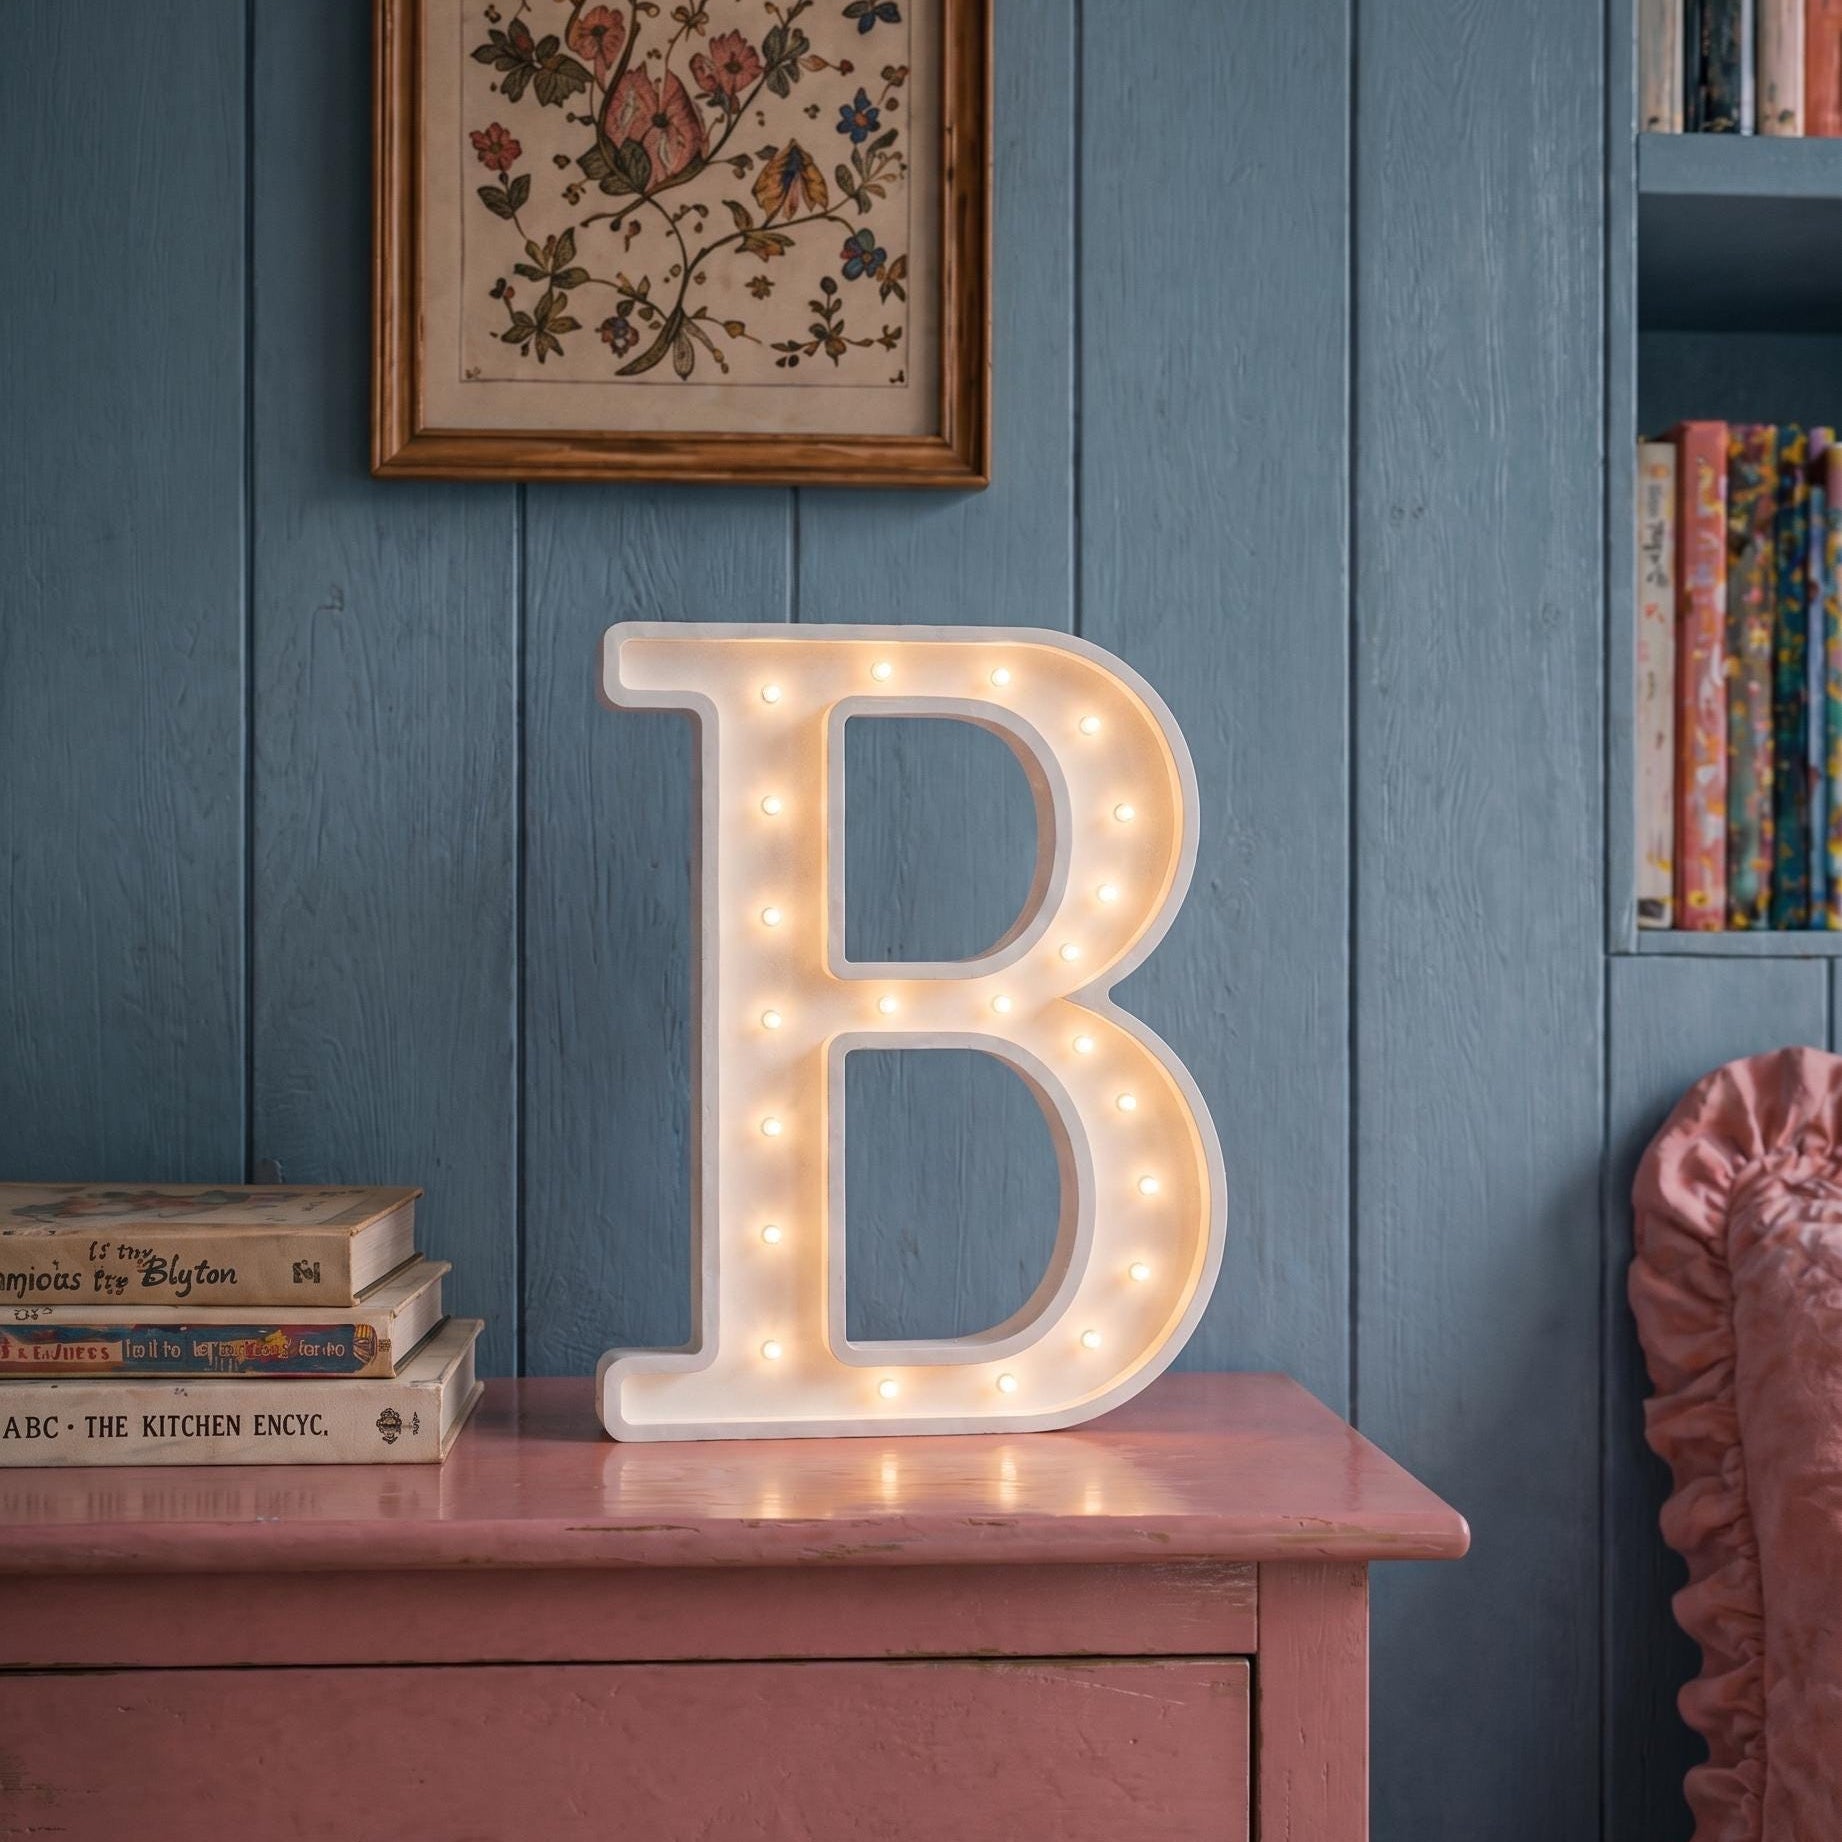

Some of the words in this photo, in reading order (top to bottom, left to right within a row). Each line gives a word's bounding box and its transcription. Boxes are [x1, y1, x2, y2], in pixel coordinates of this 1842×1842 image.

[597, 621, 1228, 1442] B
[141, 1254, 238, 1298] Blyton
[2, 1415, 60, 1439] ABC
[84, 1415, 129, 1438] THE
[142, 1414, 241, 1438] KITCHEN
[253, 1413, 328, 1437] ENCYC.
